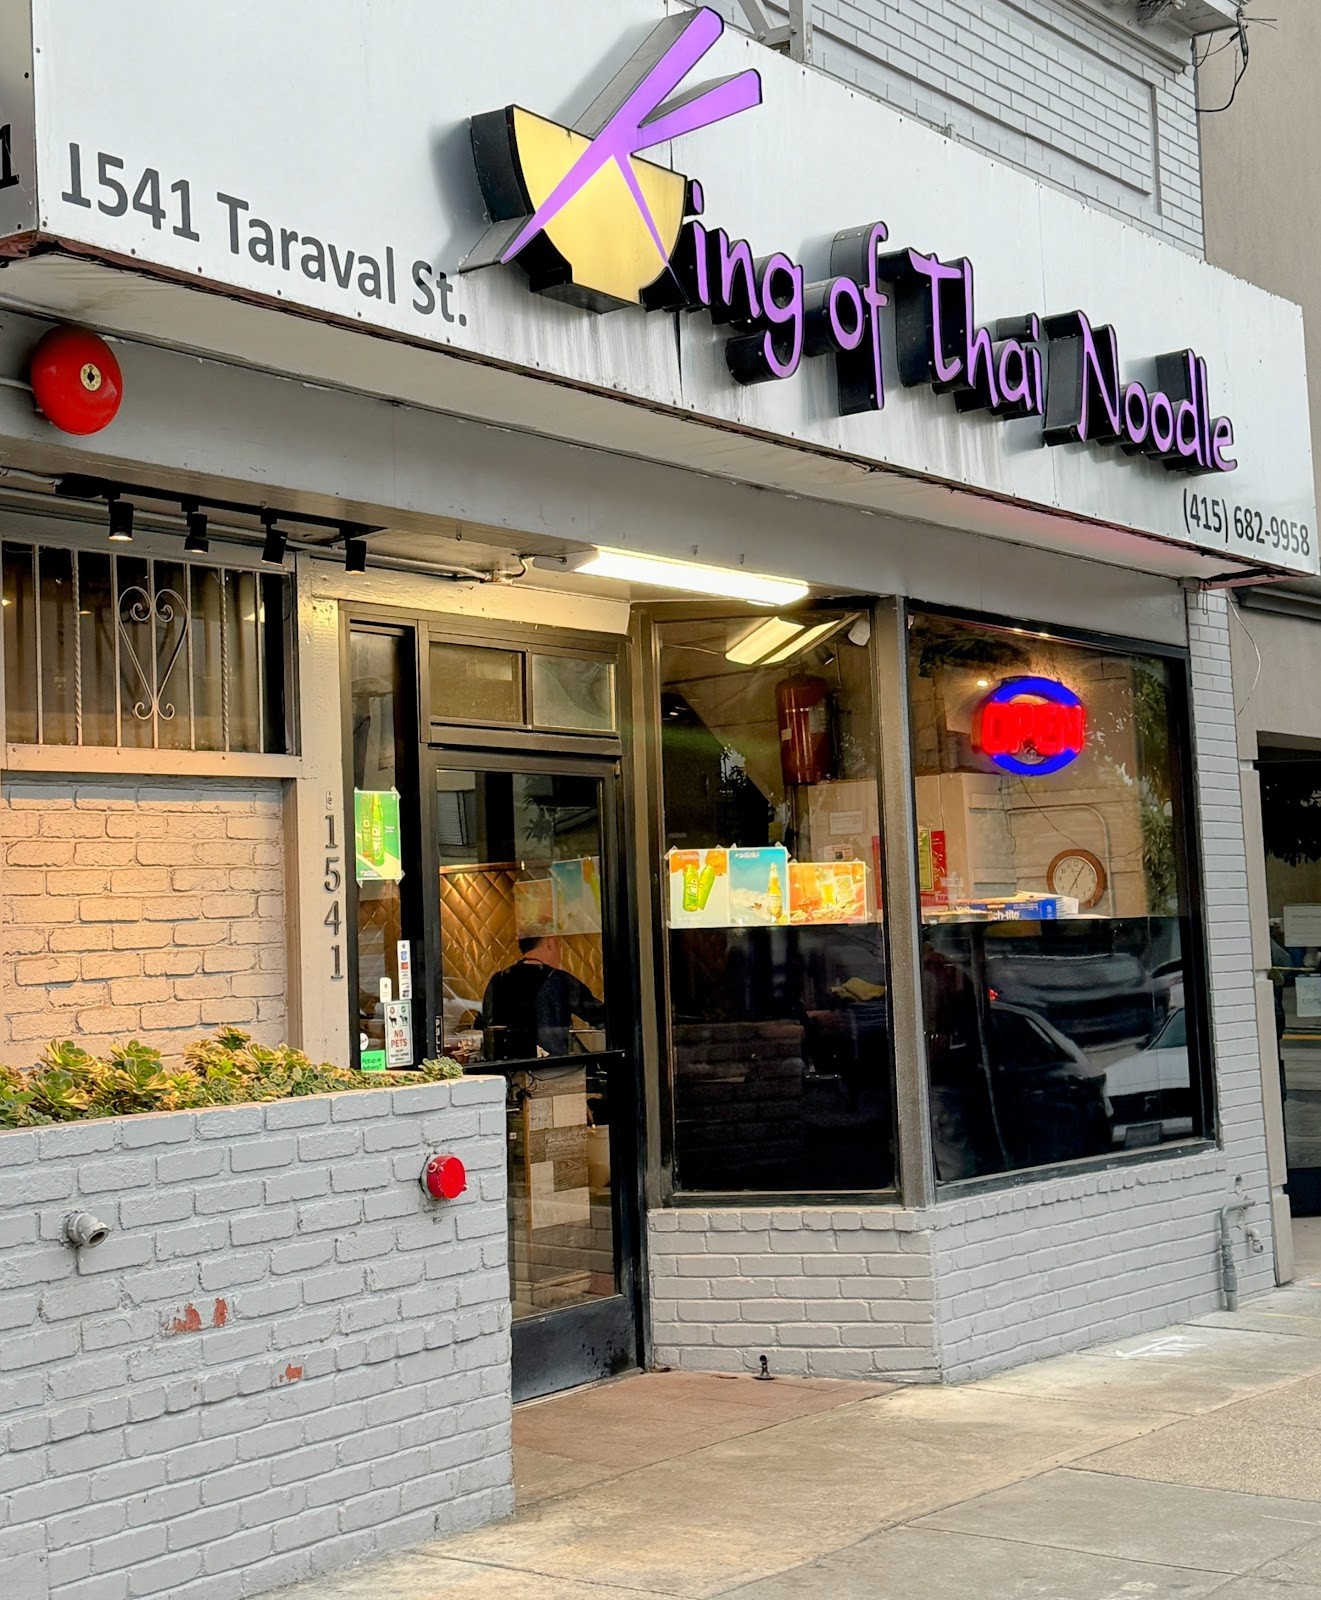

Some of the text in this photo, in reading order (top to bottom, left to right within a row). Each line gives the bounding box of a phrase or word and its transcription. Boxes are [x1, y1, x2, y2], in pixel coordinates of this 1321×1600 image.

[61, 141, 468, 328] 1541 Taraval St.
[500, 6, 1238, 472] King of Thai Noodle
[1183, 487, 1310, 557] (415) 682-9958
[981, 702, 1085, 757] OPEN
[323, 814, 344, 980] 1541
[390, 1038, 408, 1048] PETS
[394, 1029, 404, 1038] NO
